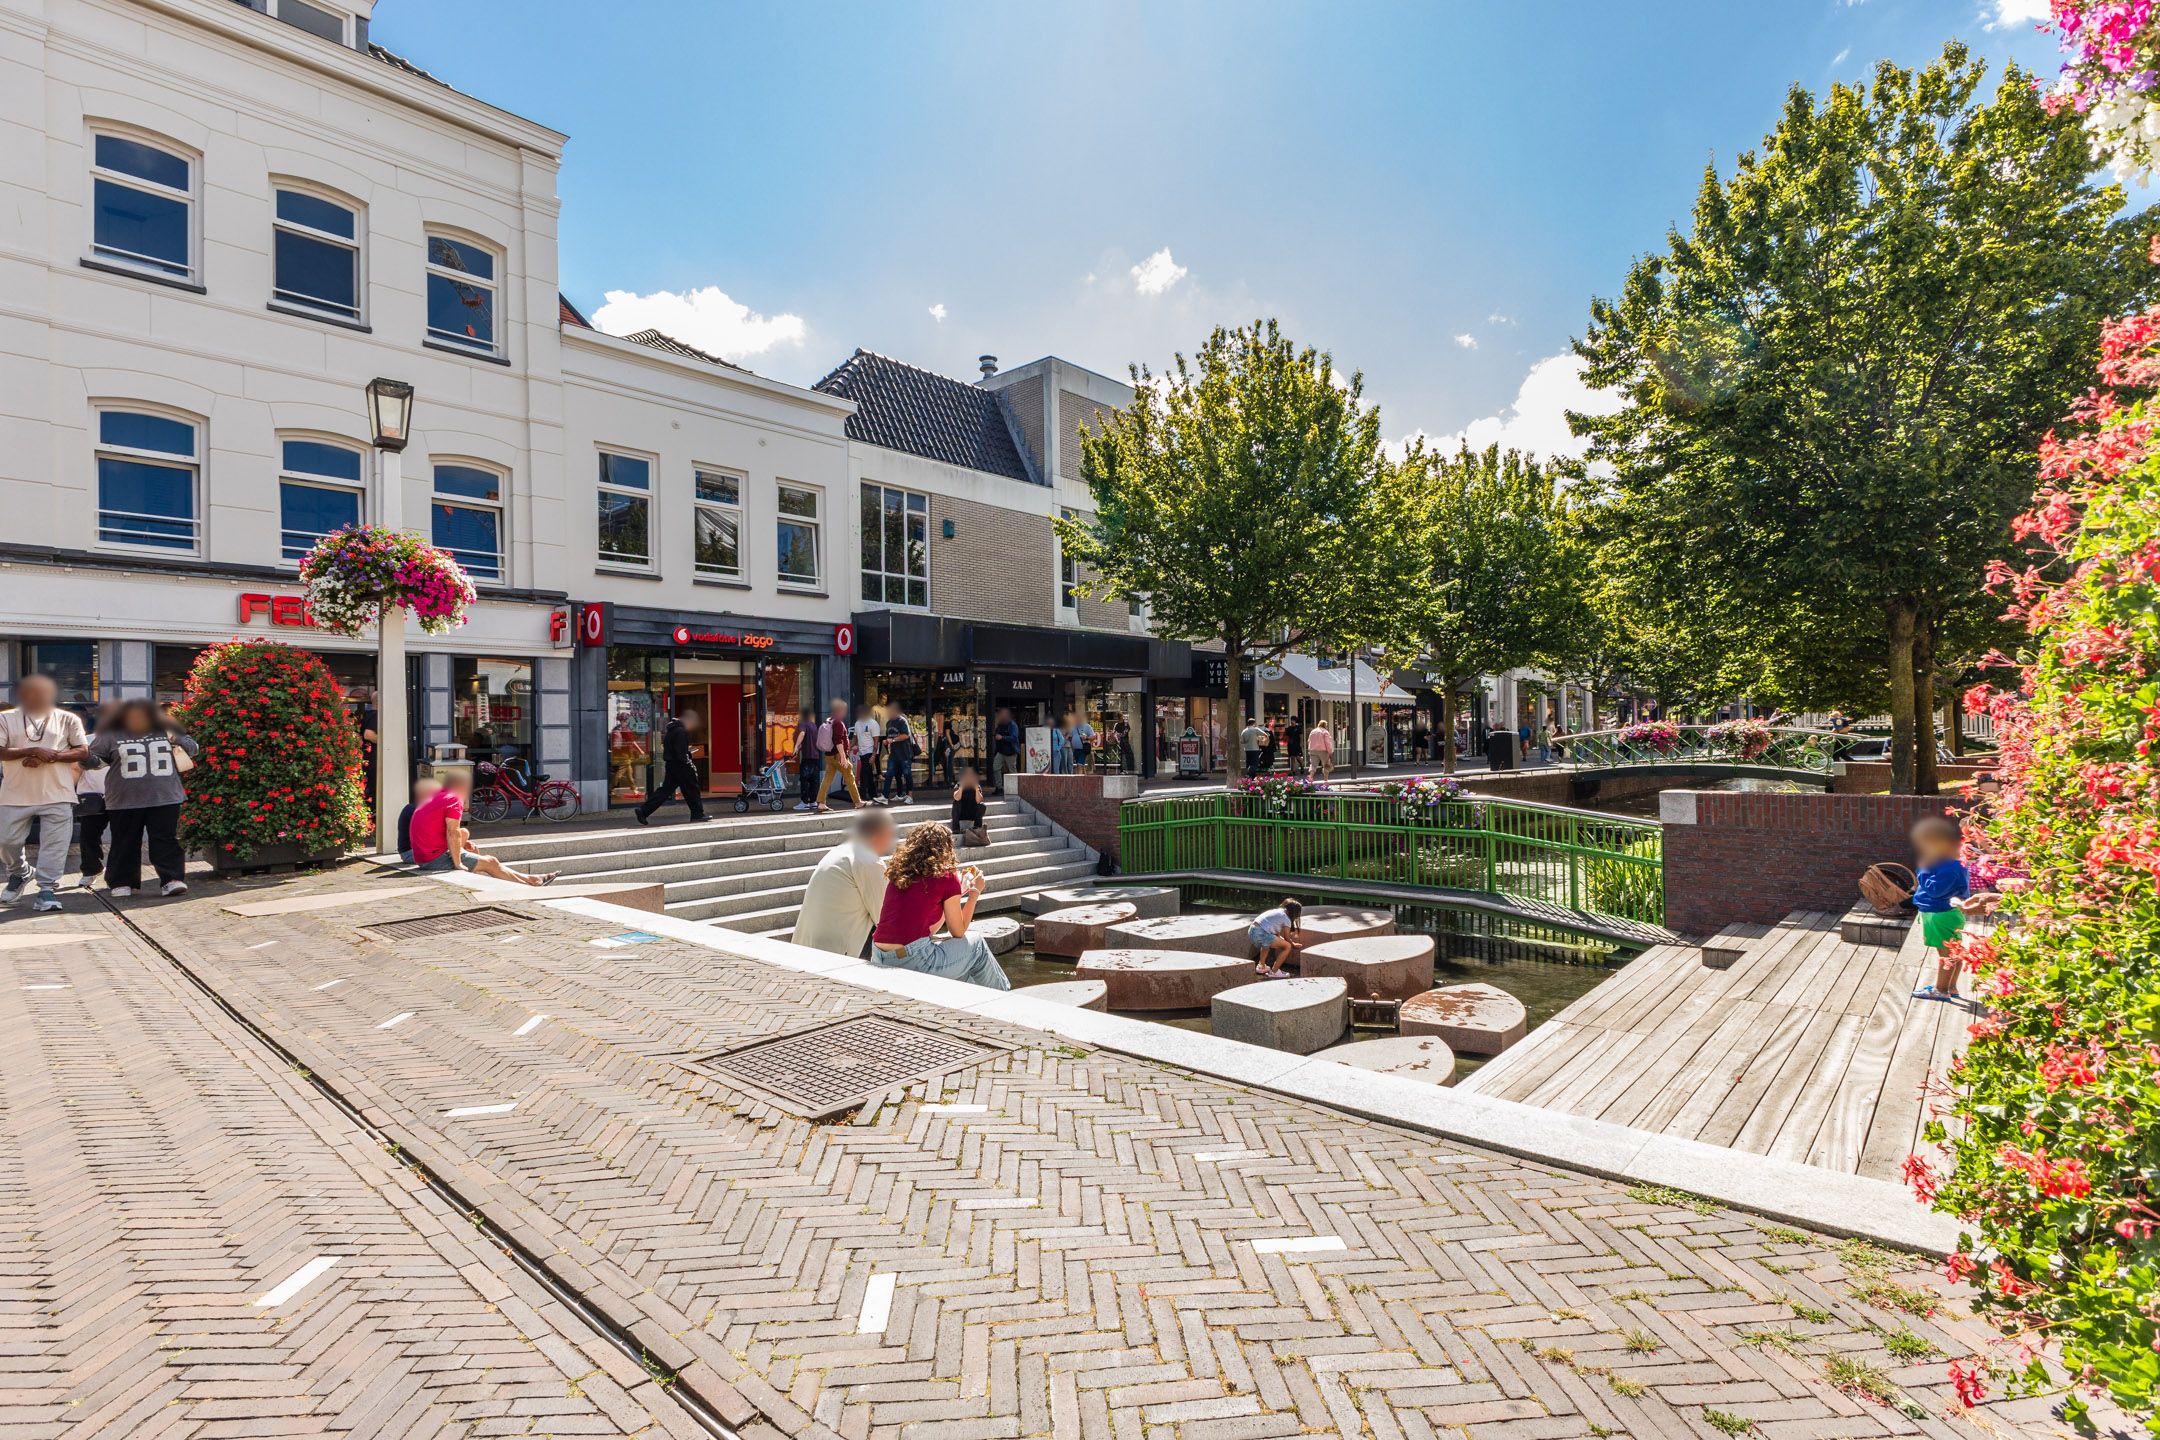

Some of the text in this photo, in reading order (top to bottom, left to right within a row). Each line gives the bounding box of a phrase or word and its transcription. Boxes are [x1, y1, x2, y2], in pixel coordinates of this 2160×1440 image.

[240, 592, 317, 628] FE
[692, 631, 774, 649] vodafone ziggo
[943, 672, 965, 683] ZAAN
[1012, 680, 1033, 690] ZAAN
[118, 740, 174, 780] 66
[1182, 756, 1197, 764] 70%
